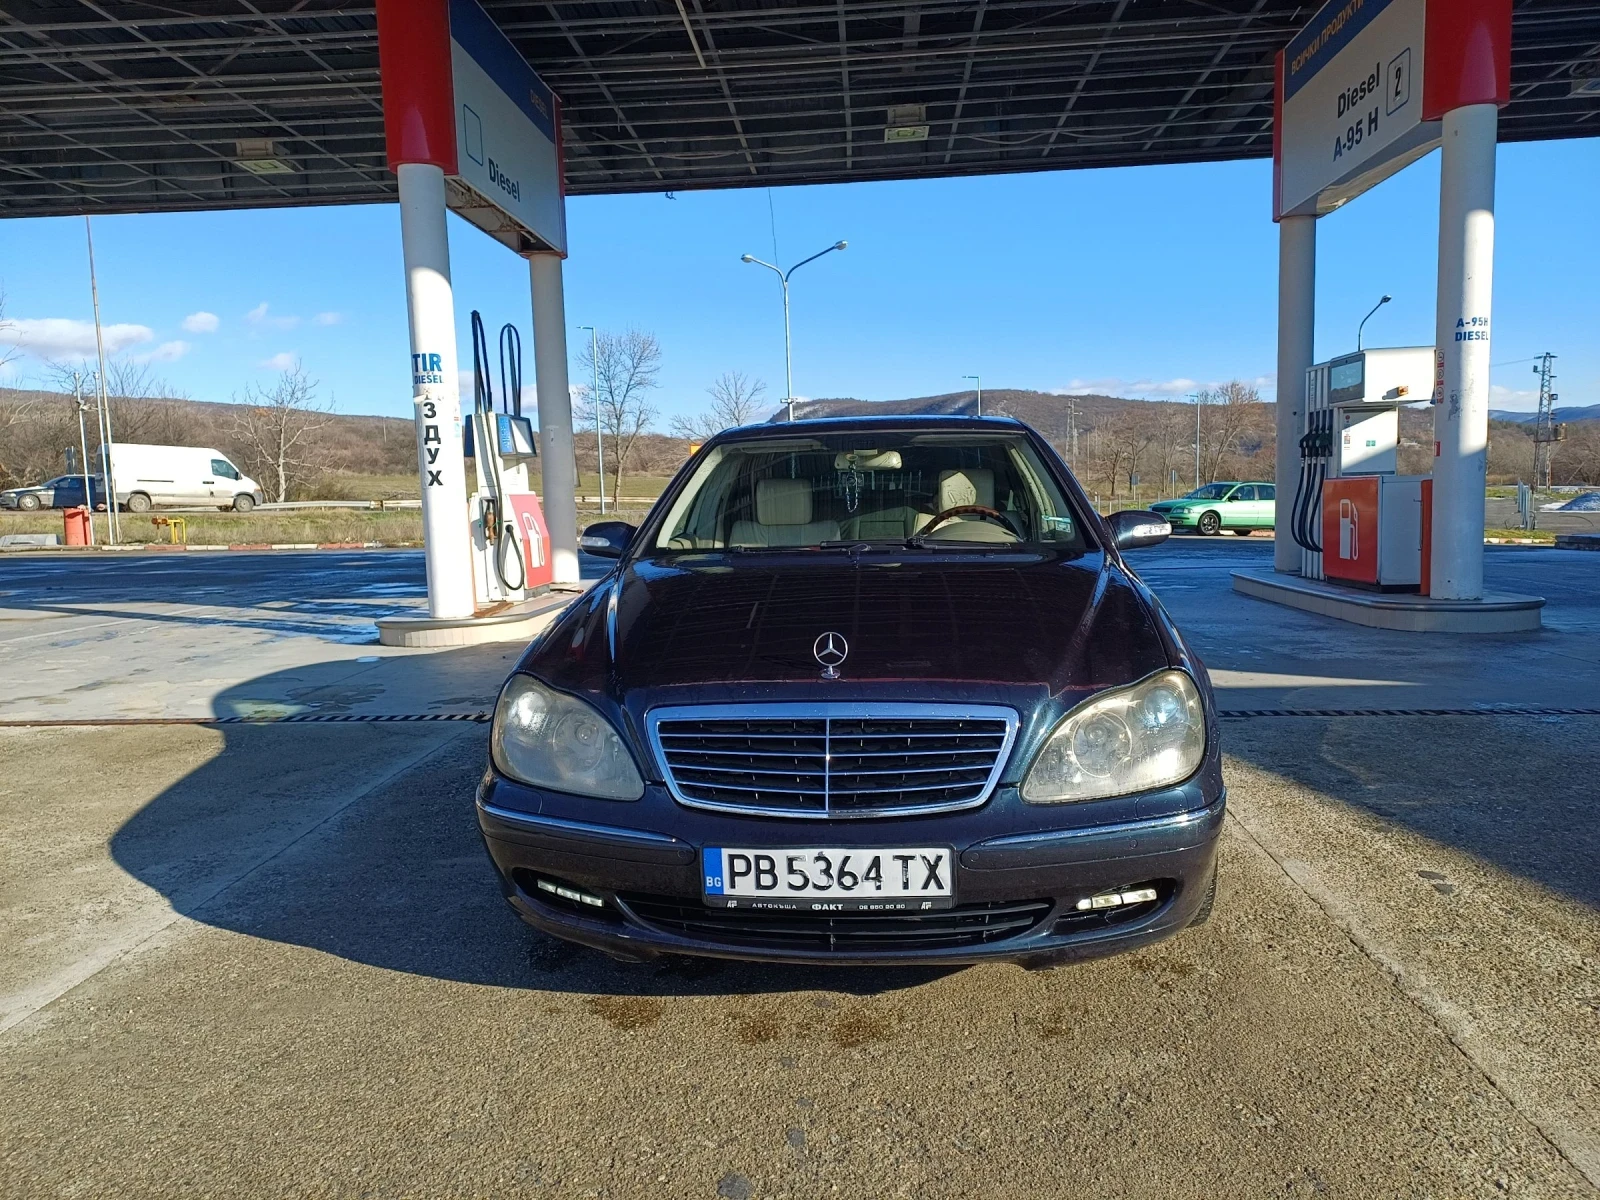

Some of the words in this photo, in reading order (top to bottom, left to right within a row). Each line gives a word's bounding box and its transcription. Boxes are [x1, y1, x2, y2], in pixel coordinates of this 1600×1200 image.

[1291, 35, 1320, 76] ВСИЧКИ
[1337, 62, 1381, 119] Diesel
[1394, 66, 1403, 98] 2
[1333, 119, 1363, 162] A-95
[488, 157, 521, 203] Diesel
[1455, 317, 1489, 328] A-95H
[1455, 331, 1489, 342] DIESEL
[412, 353, 443, 373] TIR
[414, 375, 444, 385] DIESEL
[706, 876, 722, 888] BG
[727, 854, 779, 891] PB
[786, 854, 883, 891] 5364
[892, 854, 945, 891] TX
[811, 903, 844, 911] ФАКТ
